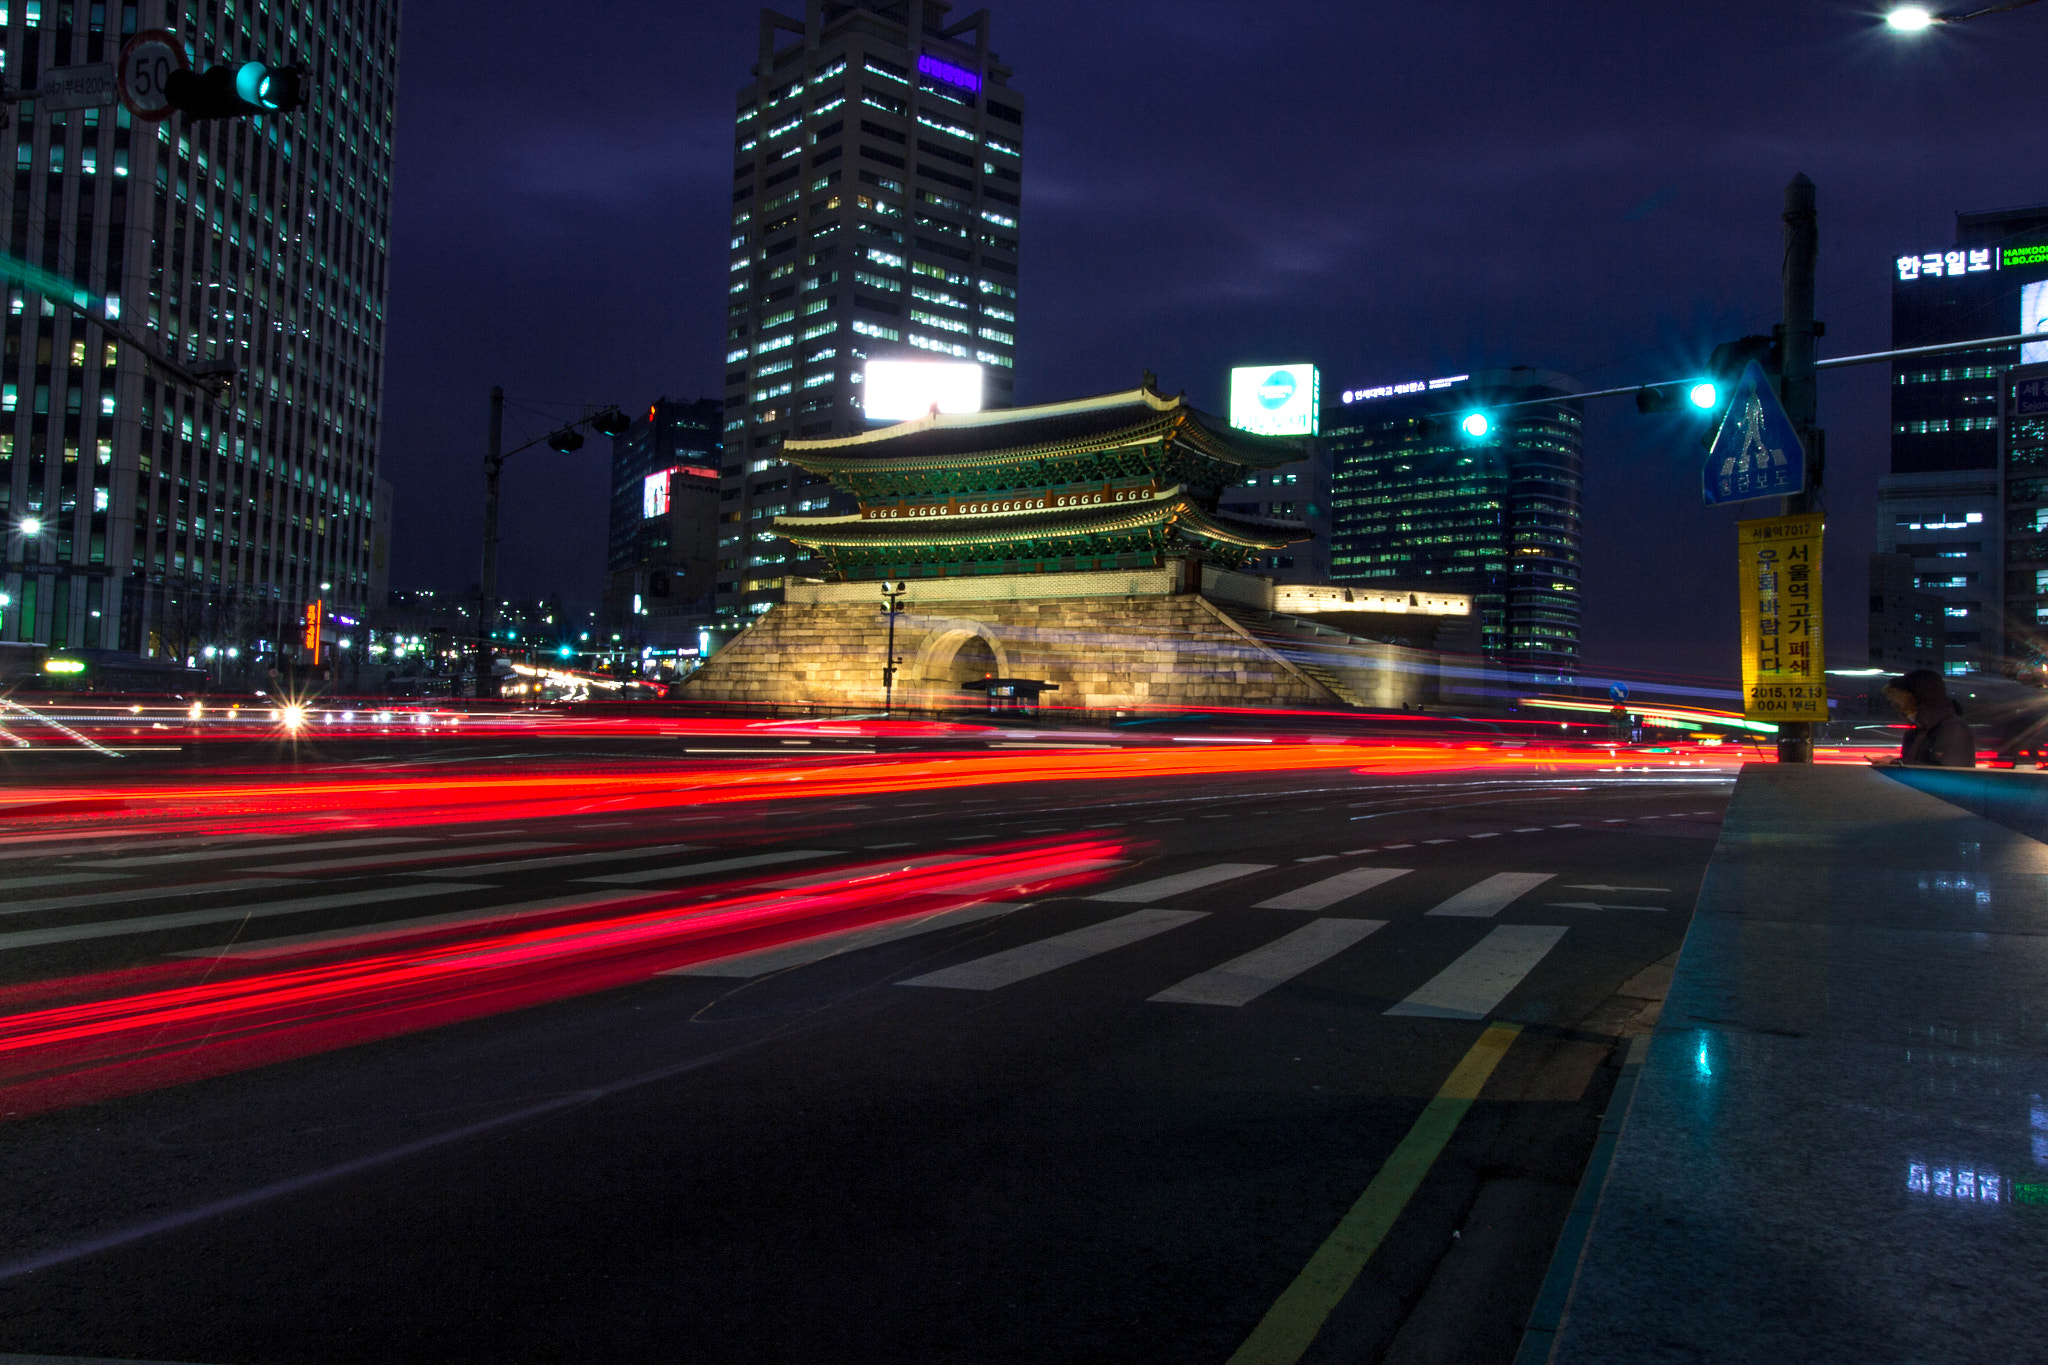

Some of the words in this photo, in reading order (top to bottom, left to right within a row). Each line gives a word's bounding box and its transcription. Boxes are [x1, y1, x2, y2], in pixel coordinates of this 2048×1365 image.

[135, 56, 170, 96] 50
[1897, 248, 1991, 280] 한국일보
[2004, 245, 2048, 257] HANKOO
[1720, 469, 1790, 497] 횡단보도
[1787, 544, 1812, 636] 서울역고가
[1787, 641, 1810, 677] 폐쇄
